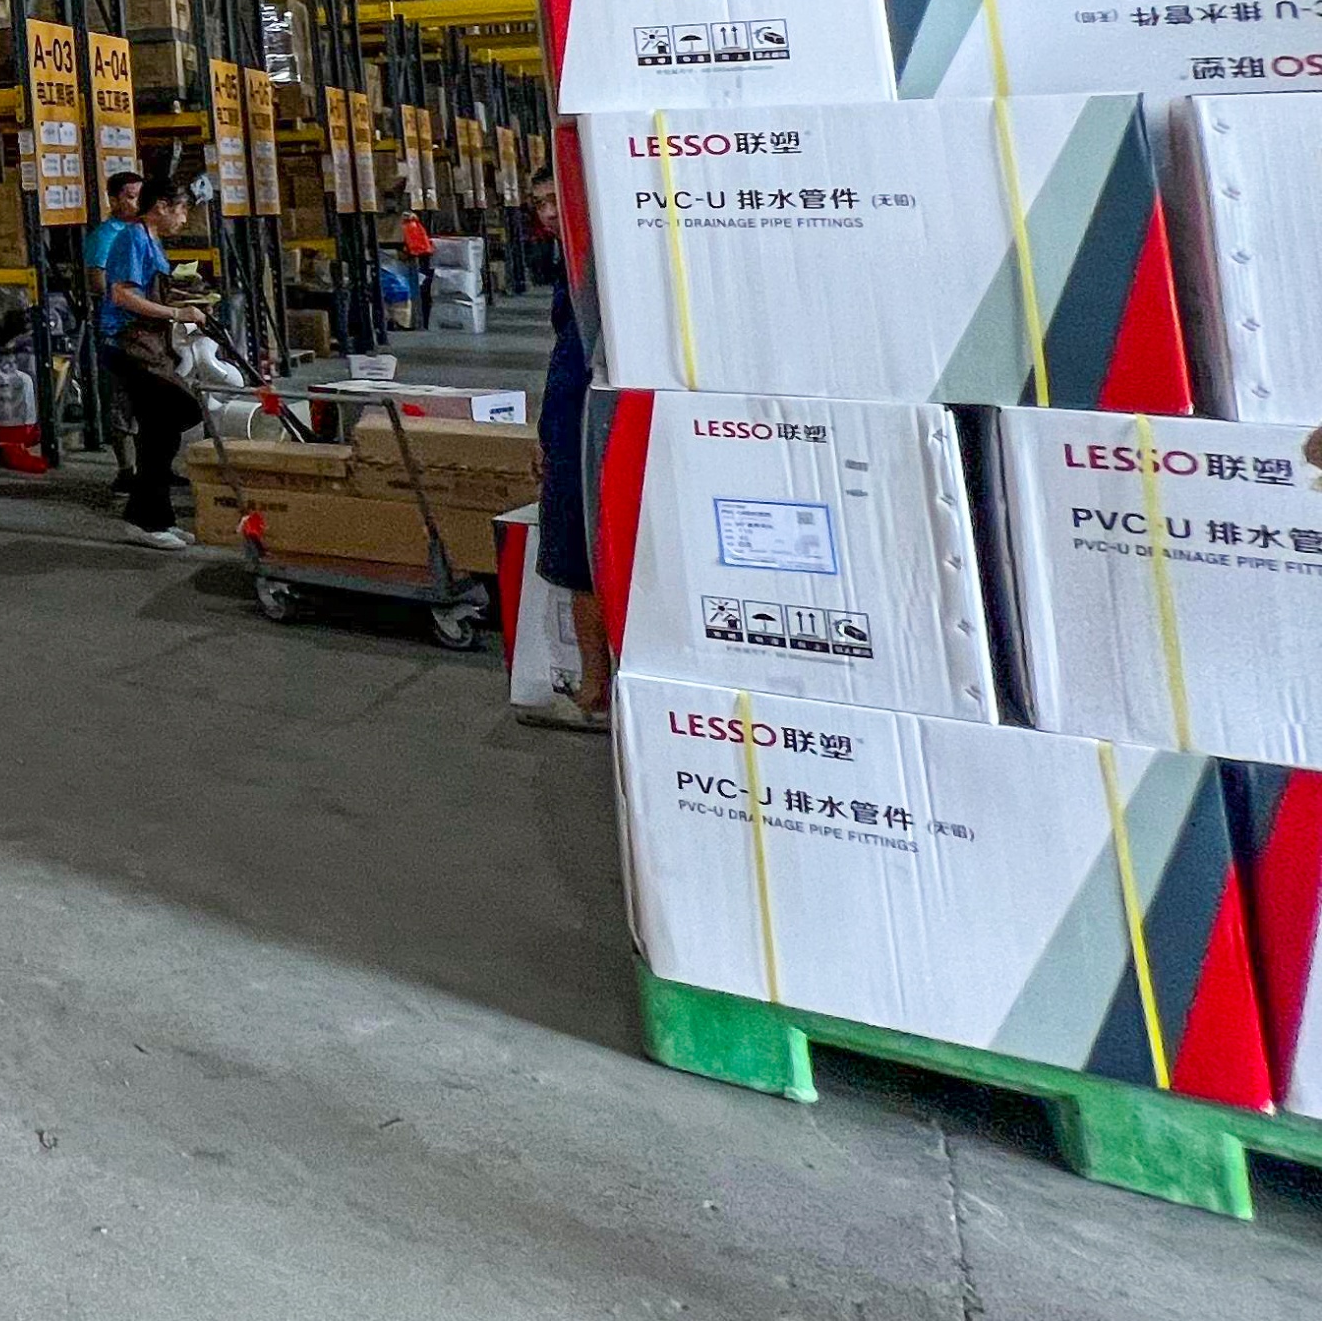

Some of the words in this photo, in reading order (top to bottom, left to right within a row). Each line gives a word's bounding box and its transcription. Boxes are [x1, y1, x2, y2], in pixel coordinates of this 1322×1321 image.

[1130, 1, 1261, 27] 排水管件
[34, 34, 74, 74] A-03
[95, 46, 129, 81] A-04
[628, 134, 731, 158] LESSO
[734, 131, 803, 155] 联塑
[636, 191, 726, 210] PVC-U
[737, 188, 860, 210] 排水管件
[684, 218, 756, 229] DRAINAGE
[760, 218, 792, 229] PIPE
[797, 217, 864, 229] FITTINGS
[693, 419, 773, 440] LESSO
[1205, 452, 1295, 487] 联塑
[1071, 507, 1191, 539] PVCU
[1073, 537, 1130, 555] PVC-U
[1237, 554, 1279, 572] PIPE
[668, 711, 777, 747] LESSO
[781, 726, 855, 761] 联塑
[677, 771, 772, 806] PVC-U
[784, 788, 915, 831] 排水管件
[678, 799, 724, 817] PVC-U
[728, 808, 805, 834] DRANAGE
[809, 823, 844, 840] PIPE
[848, 831, 920, 853] FITTINGS
